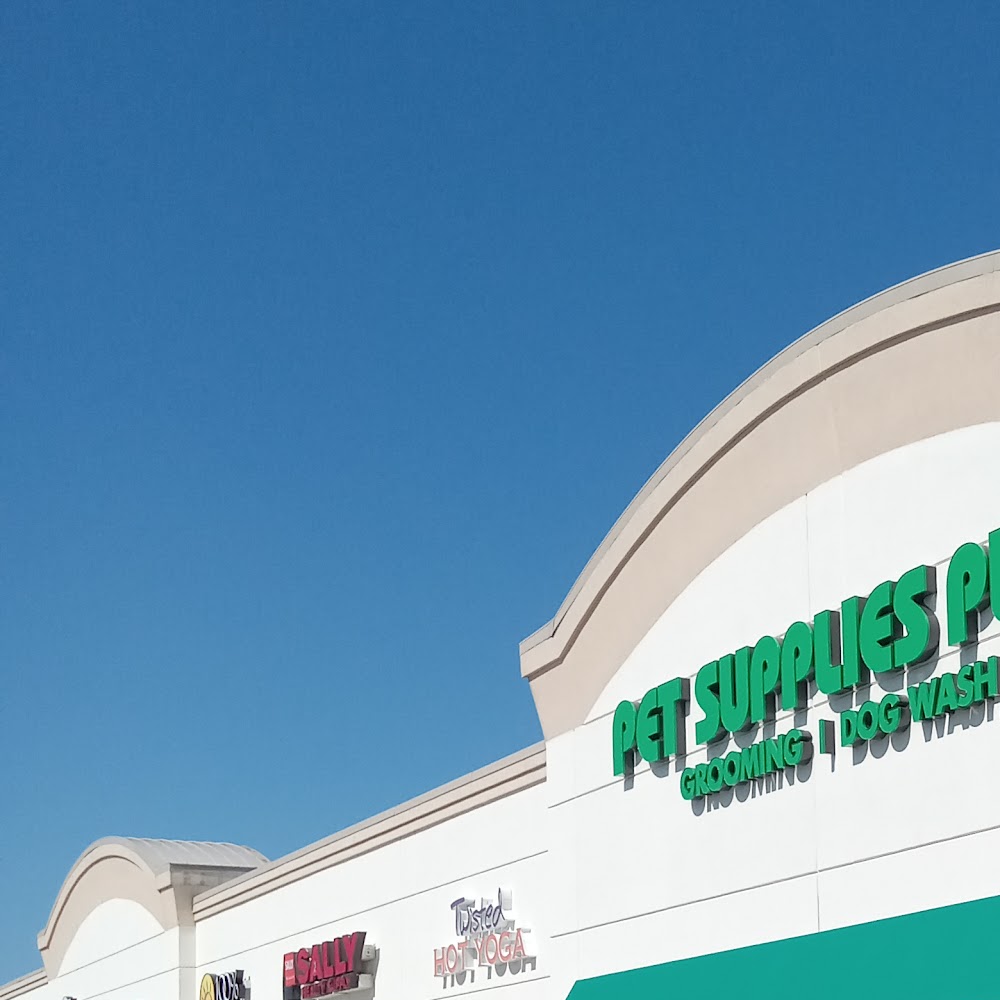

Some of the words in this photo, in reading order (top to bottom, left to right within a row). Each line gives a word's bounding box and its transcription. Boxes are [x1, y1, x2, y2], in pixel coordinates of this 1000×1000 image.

[613, 677, 684, 777] PET
[695, 565, 934, 746] SUPPLIES
[680, 729, 806, 801] GROOMING
[841, 694, 903, 748] DOG
[450, 887, 505, 936] Twisted
[297, 931, 361, 985] SALLY
[434, 941, 469, 977] HOT
[474, 927, 526, 966] YOGA
